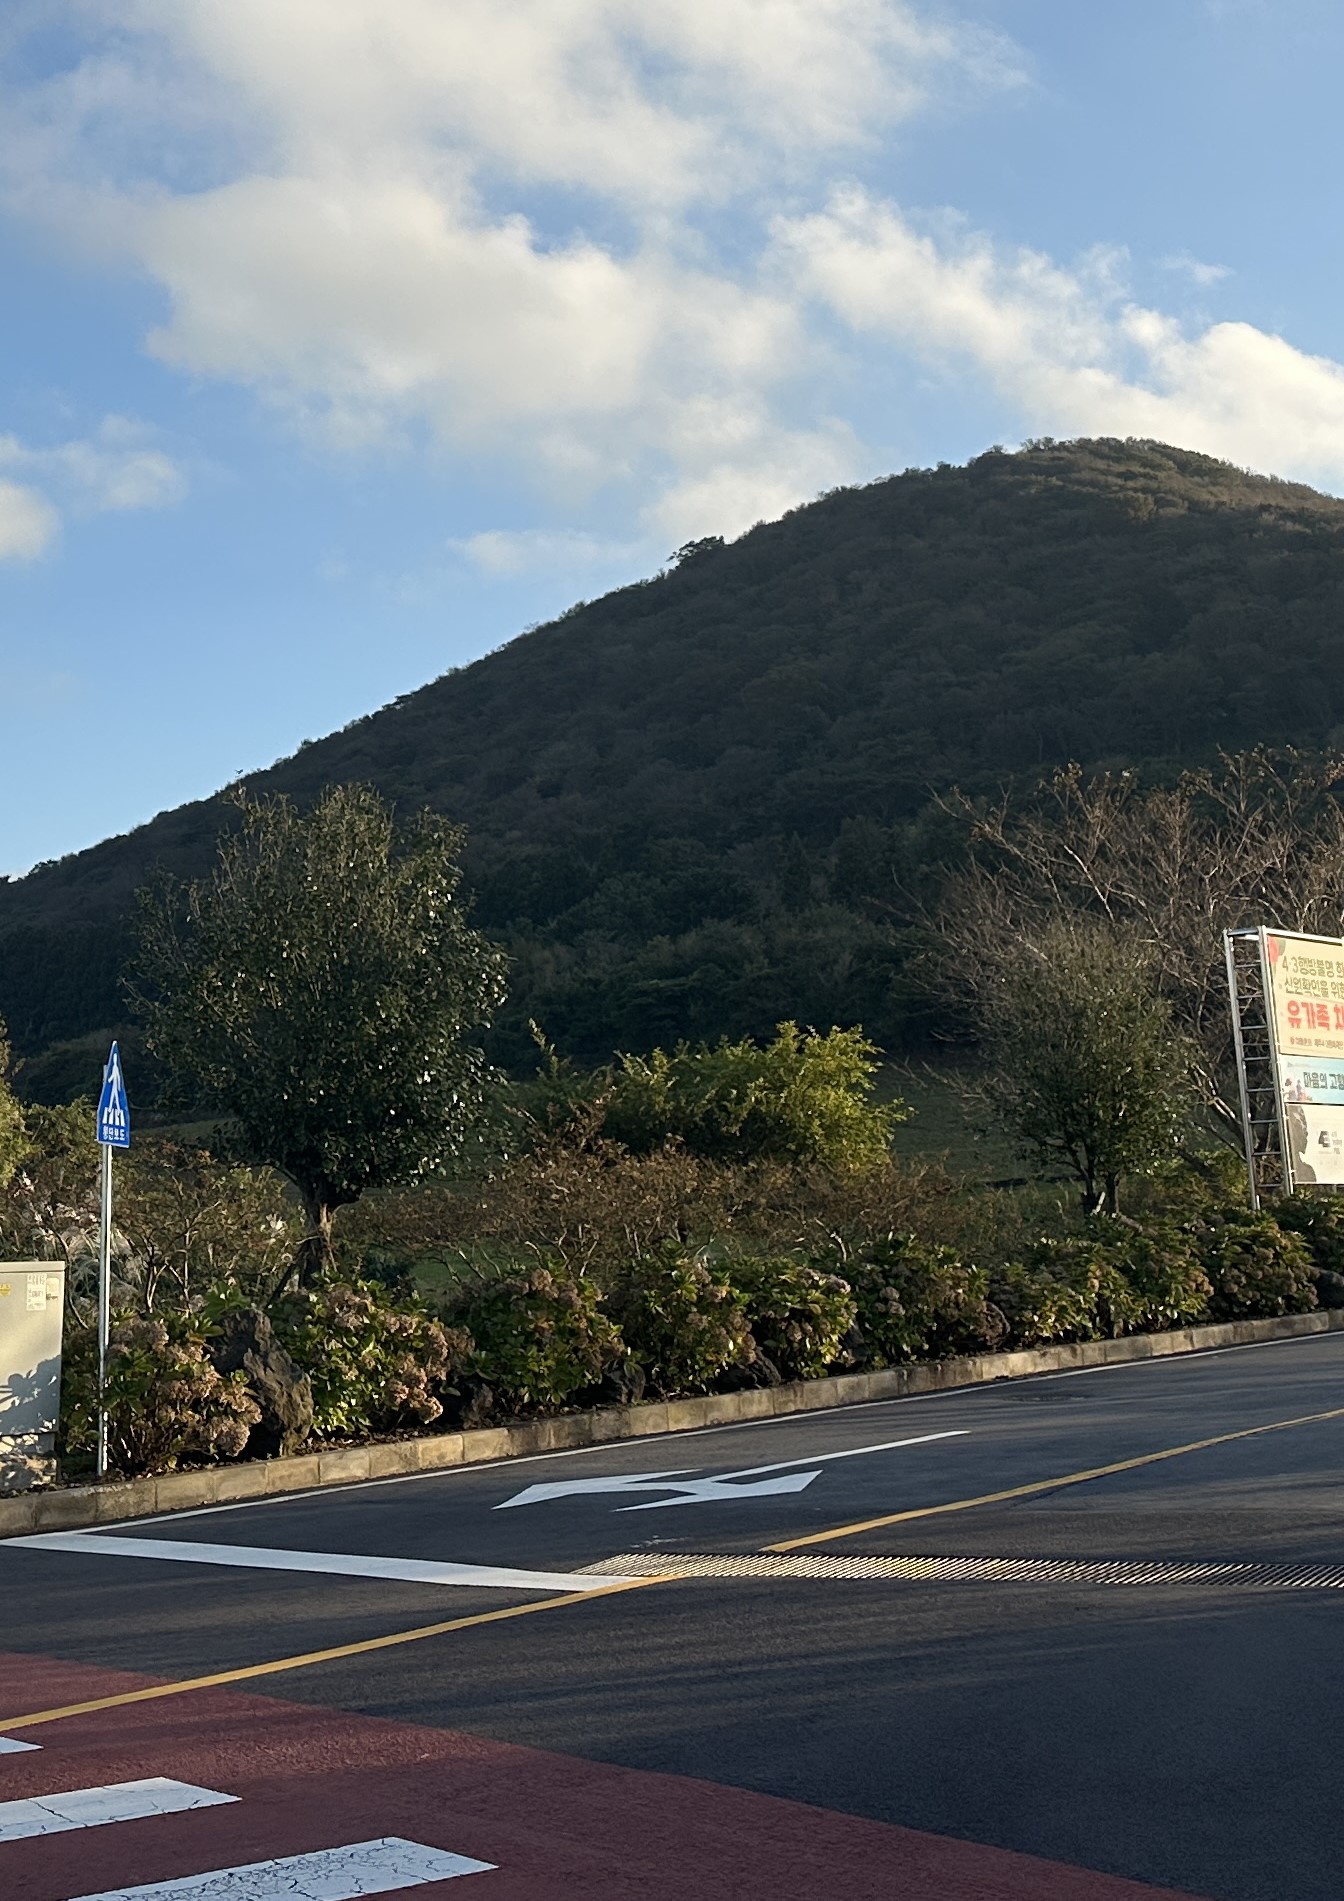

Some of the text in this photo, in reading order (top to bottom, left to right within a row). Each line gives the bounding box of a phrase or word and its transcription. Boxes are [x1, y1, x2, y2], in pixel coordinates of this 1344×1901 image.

[1285, 976, 1329, 998] 신원확인을
[1287, 1000, 1330, 1031] 유가족
[1303, 1072, 1328, 1089] 마음의
[1329, 1073, 1344, 1090] 고향
[103, 1125, 125, 1141] 횡단보도
